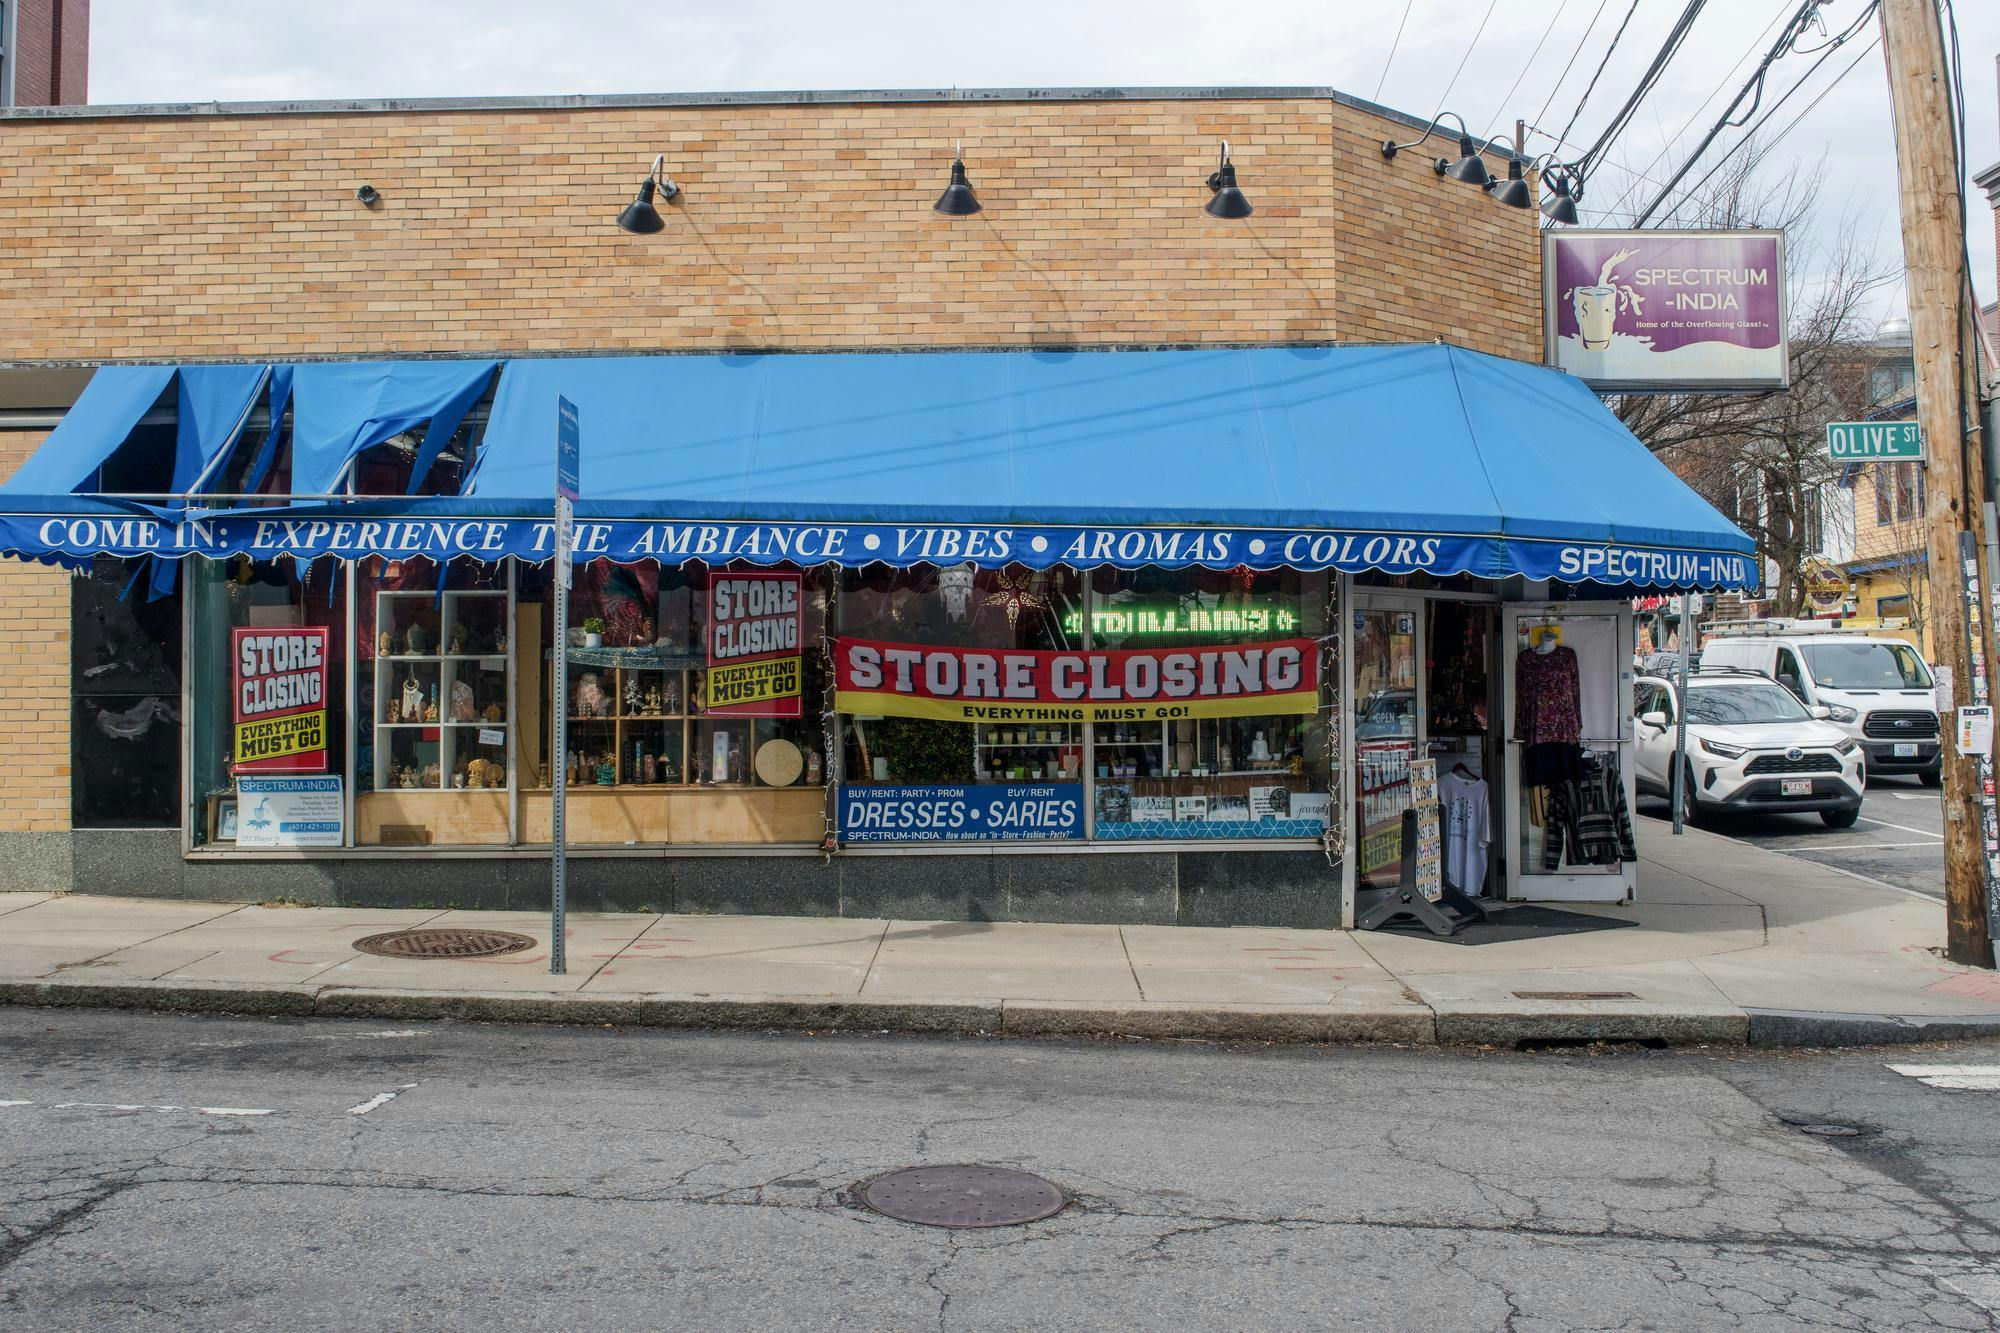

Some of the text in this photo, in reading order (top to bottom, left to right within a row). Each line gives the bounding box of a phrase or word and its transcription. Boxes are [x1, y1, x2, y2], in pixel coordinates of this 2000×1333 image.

[1635, 268, 1768, 286] SPECTRUM
[1665, 292, 1740, 310] -INDIA
[1660, 320, 1670, 328] of
[1671, 320, 1684, 328] the
[1686, 320, 1735, 330] Overflowing
[1736, 320, 1762, 328] Glass!
[1832, 426, 1917, 454] OLIVE ST
[39, 520, 160, 548] COME
[174, 520, 228, 548] IN:
[250, 521, 508, 551] EXPERIENCE
[530, 524, 613, 552] THE
[628, 525, 848, 556] AMBIANCE
[896, 529, 1014, 558] VIBES
[1060, 531, 1232, 560] AROMAS
[1284, 534, 1441, 565] COLORS
[715, 579, 798, 621] STORE
[715, 617, 797, 659] CLOSING
[241, 636, 322, 677] STORE
[713, 660, 796, 685] EVERYTHING
[848, 645, 1301, 700] STORE CLOSING
[241, 671, 321, 715] CLOSING
[713, 674, 796, 702] MUST GO
[963, 705, 1190, 721] EVERYTHING MUST GO!
[1375, 712, 1395, 723] OPEN
[240, 715, 320, 740] EVERYTHING
[240, 729, 321, 758] MUST GO
[1362, 750, 1409, 791] STORE
[241, 781, 338, 791] SPECTRUM-INDIA
[848, 789, 964, 798] BUY/RENT: PARTY PROM
[1007, 788, 1055, 798] BUY/RENT
[847, 801, 966, 828] DRESSES
[987, 800, 1077, 827] SARIES
[1364, 782, 1410, 827] CLOSING
[288, 823, 338, 831] (401) 421-1010
[848, 831, 943, 840] SPECTRUM-INDIA:
[945, 831, 959, 839] How
[961, 831, 978, 839] about
[1364, 843, 1396, 869] MUST
